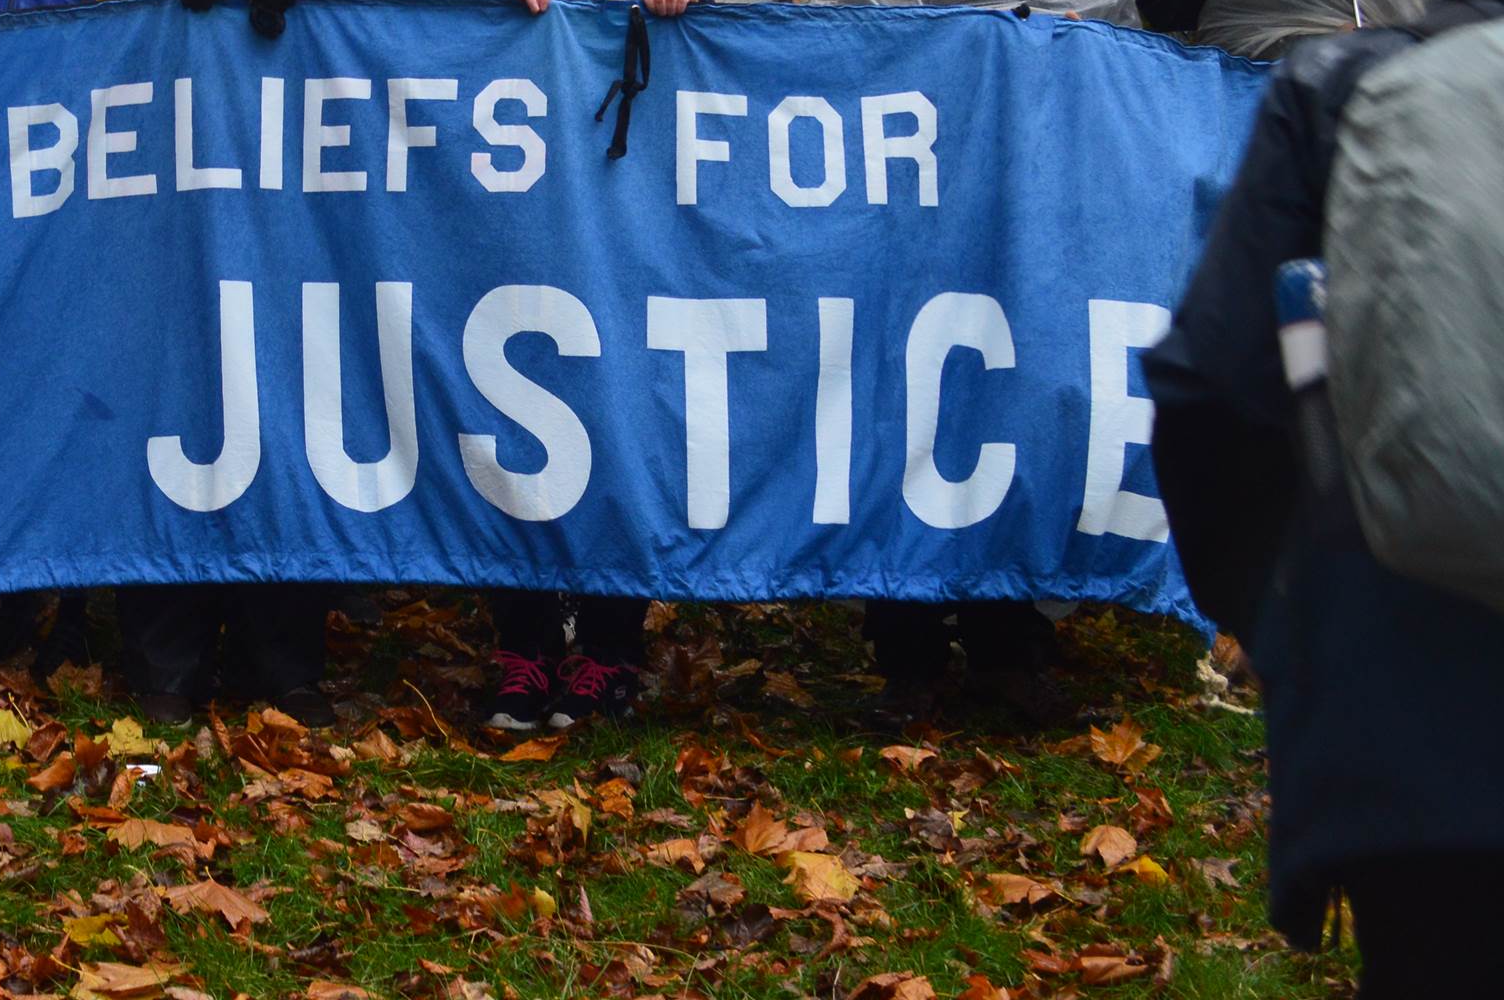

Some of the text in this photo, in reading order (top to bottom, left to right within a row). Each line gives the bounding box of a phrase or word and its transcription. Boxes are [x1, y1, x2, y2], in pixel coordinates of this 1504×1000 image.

[7, 77, 548, 218] BELIEFS
[676, 90, 939, 207] FOR
[146, 280, 1172, 543] JUSTICE
